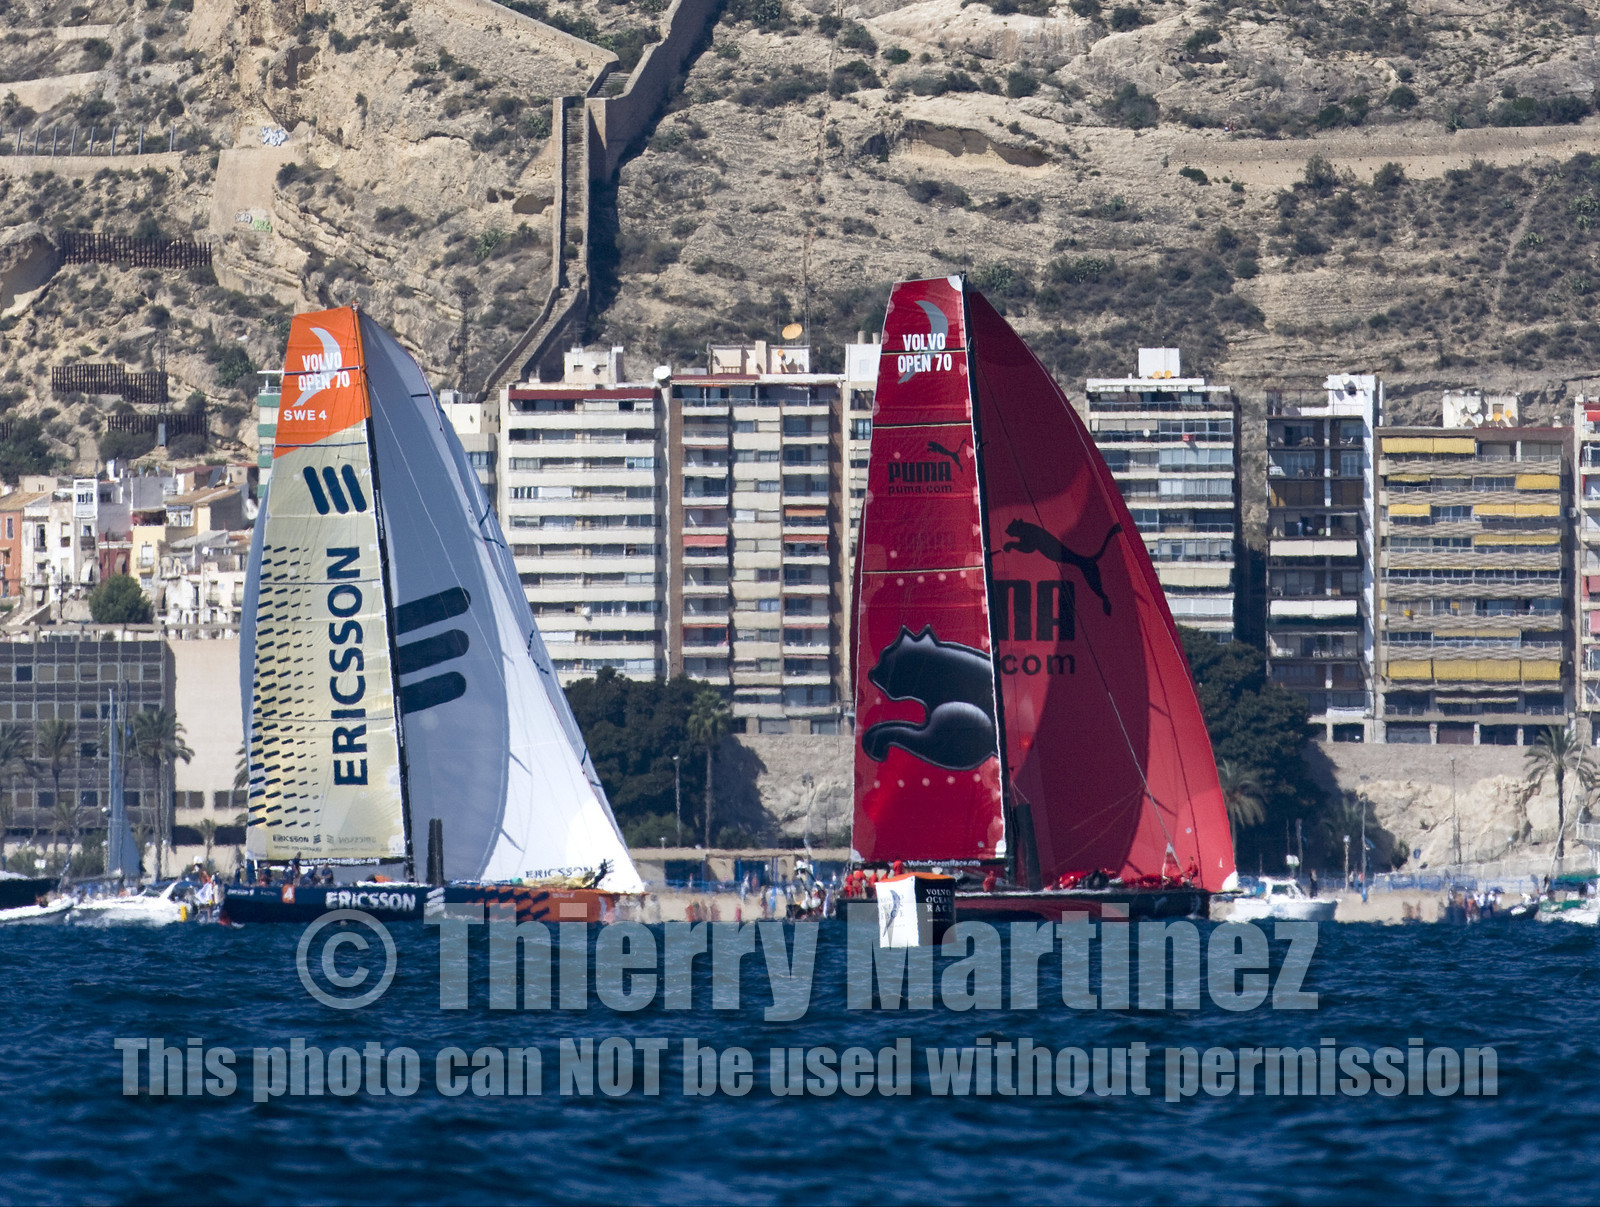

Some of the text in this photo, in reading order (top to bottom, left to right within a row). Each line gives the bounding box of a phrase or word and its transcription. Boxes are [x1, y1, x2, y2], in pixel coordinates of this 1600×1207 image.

[902, 332, 946, 352] VOLVO
[301, 351, 342, 372] VOLVO
[897, 353, 953, 373] OPEN 70
[298, 370, 351, 392] OPEN 70
[283, 409, 327, 421] SWE 4
[888, 461, 952, 483] PUMA
[888, 484, 952, 496] puma.com
[994, 579, 1075, 641] MA
[326, 546, 368, 786] ERICSSON
[283, 887, 295, 901] 4
[325, 890, 417, 912] ERICSSON
[925, 888, 951, 896] VOLVO
